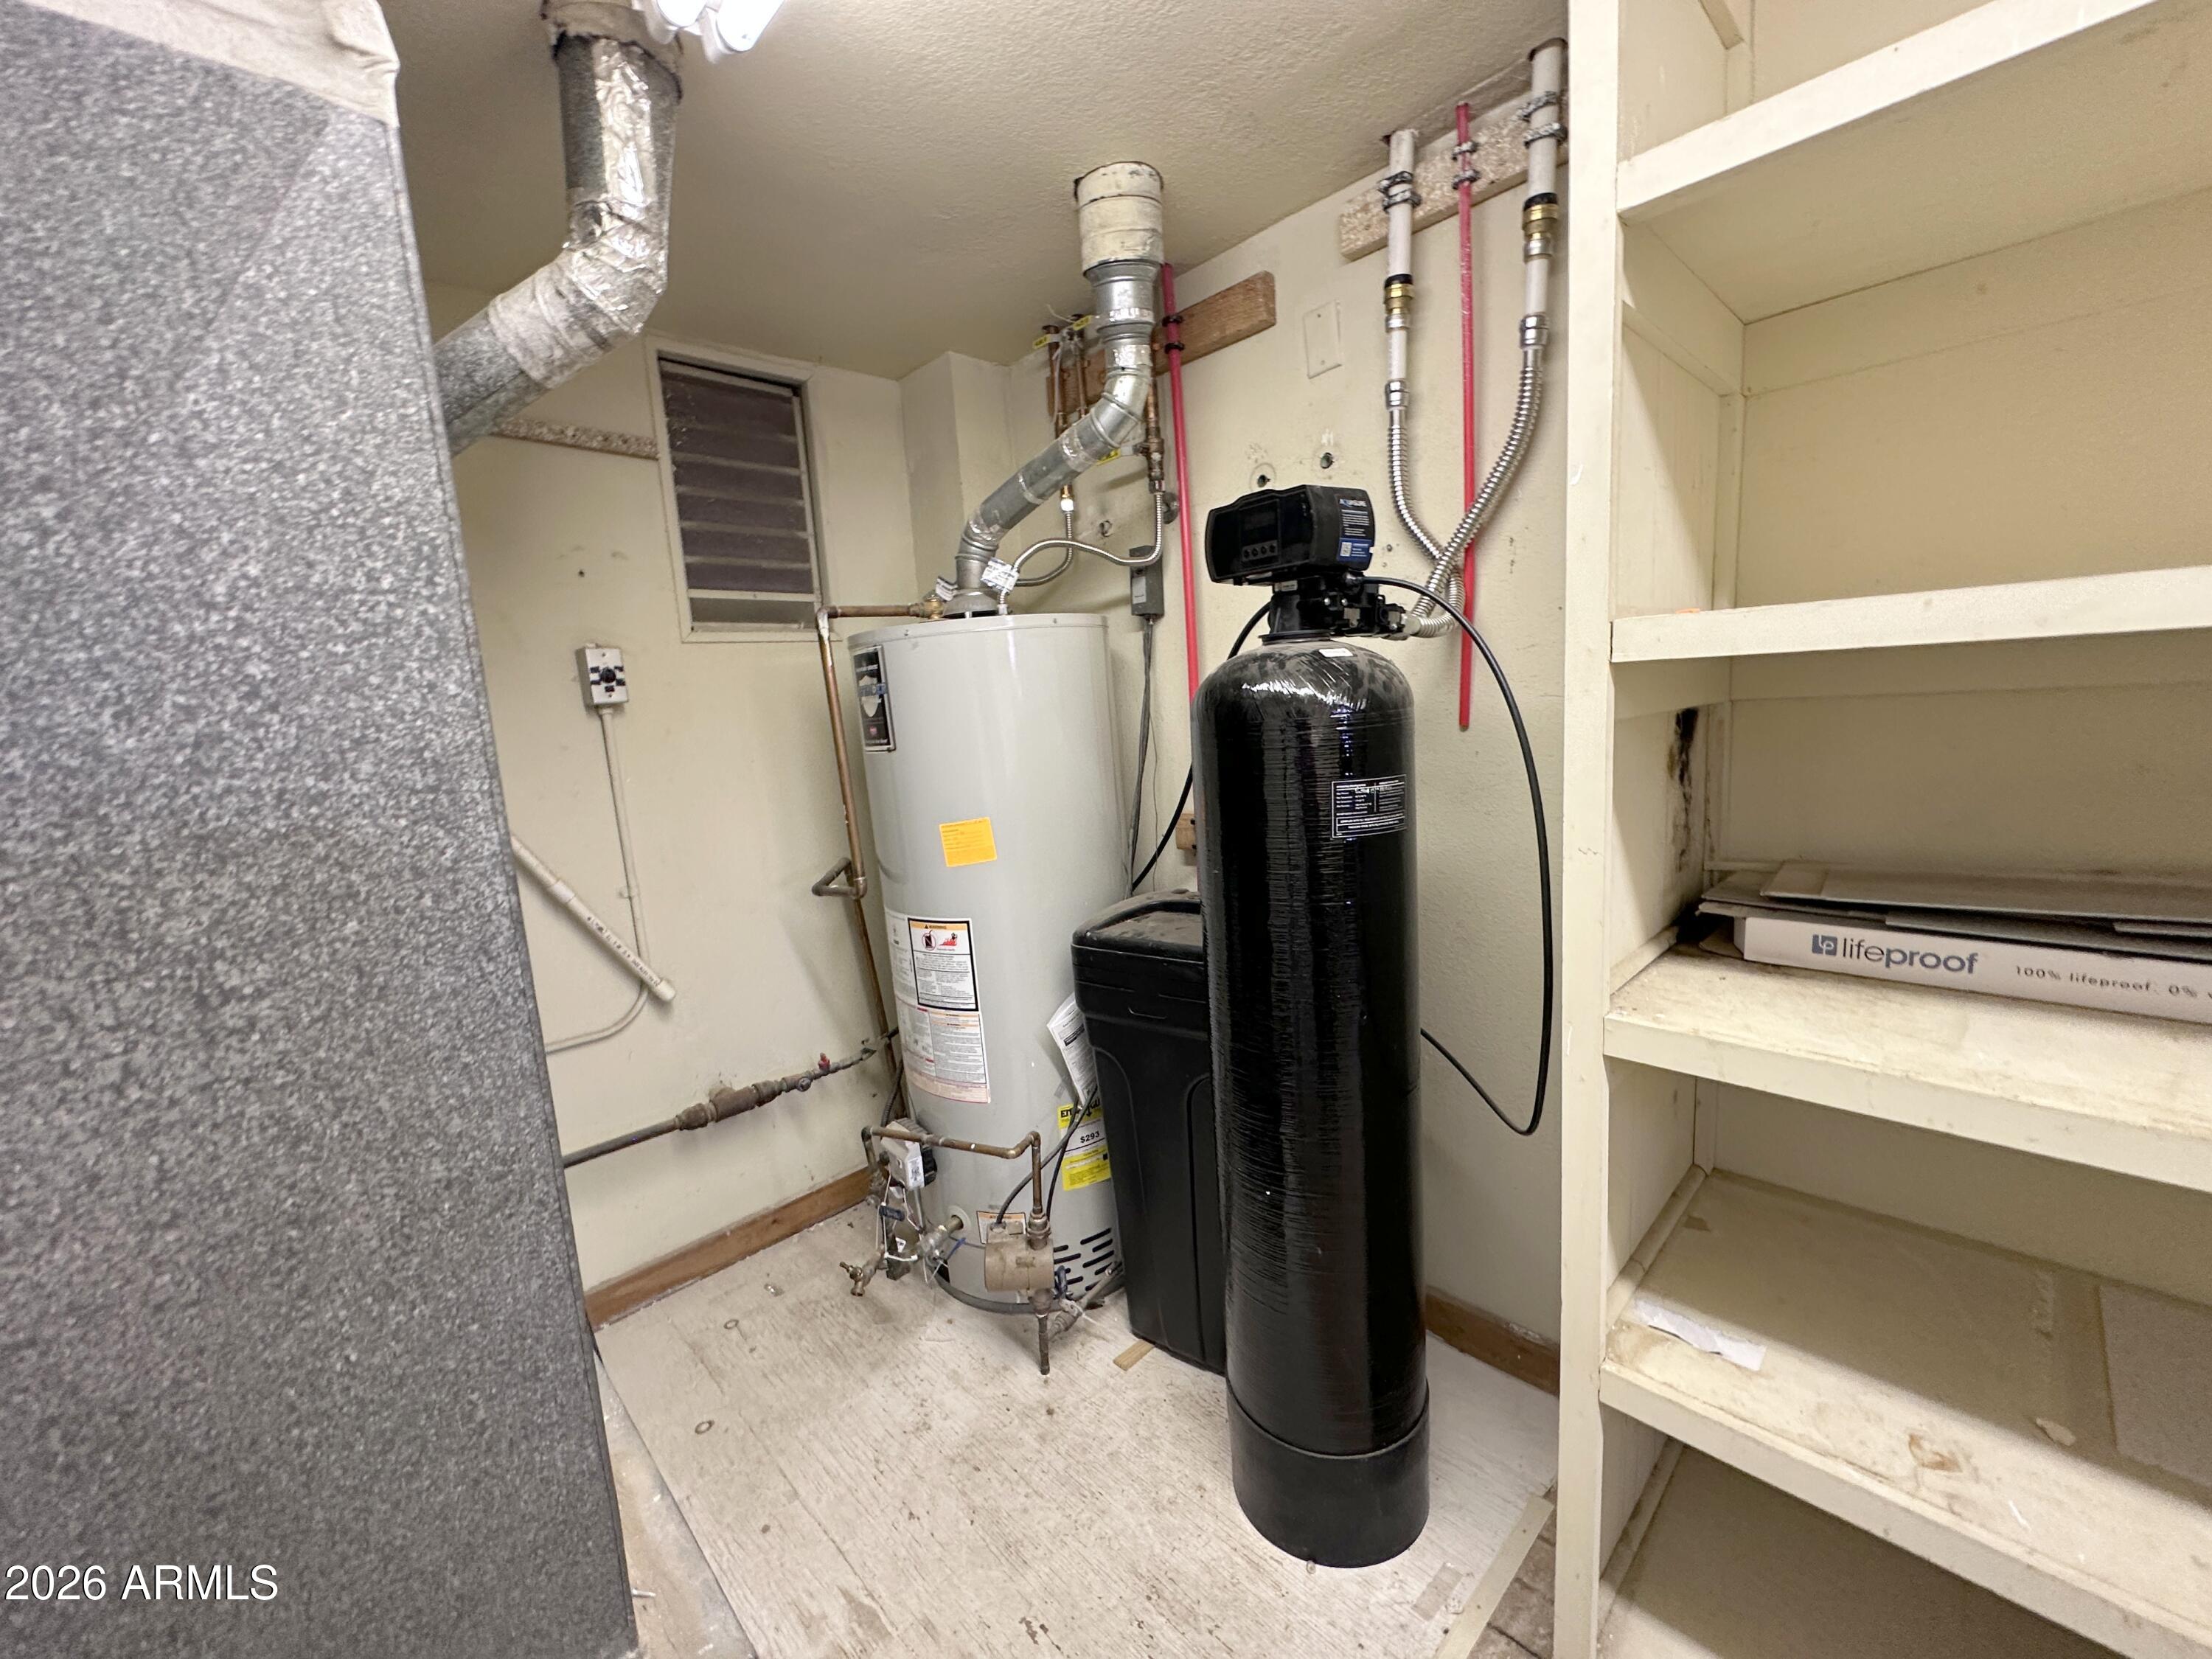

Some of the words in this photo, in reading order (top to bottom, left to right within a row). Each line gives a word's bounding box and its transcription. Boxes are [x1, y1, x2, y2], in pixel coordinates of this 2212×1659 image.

[1843, 938, 1978, 973] lifeproof
[2016, 966, 2061, 981] 100%
[2168, 985, 2197, 998] 0%
[1080, 1130, 1100, 1144] $293
